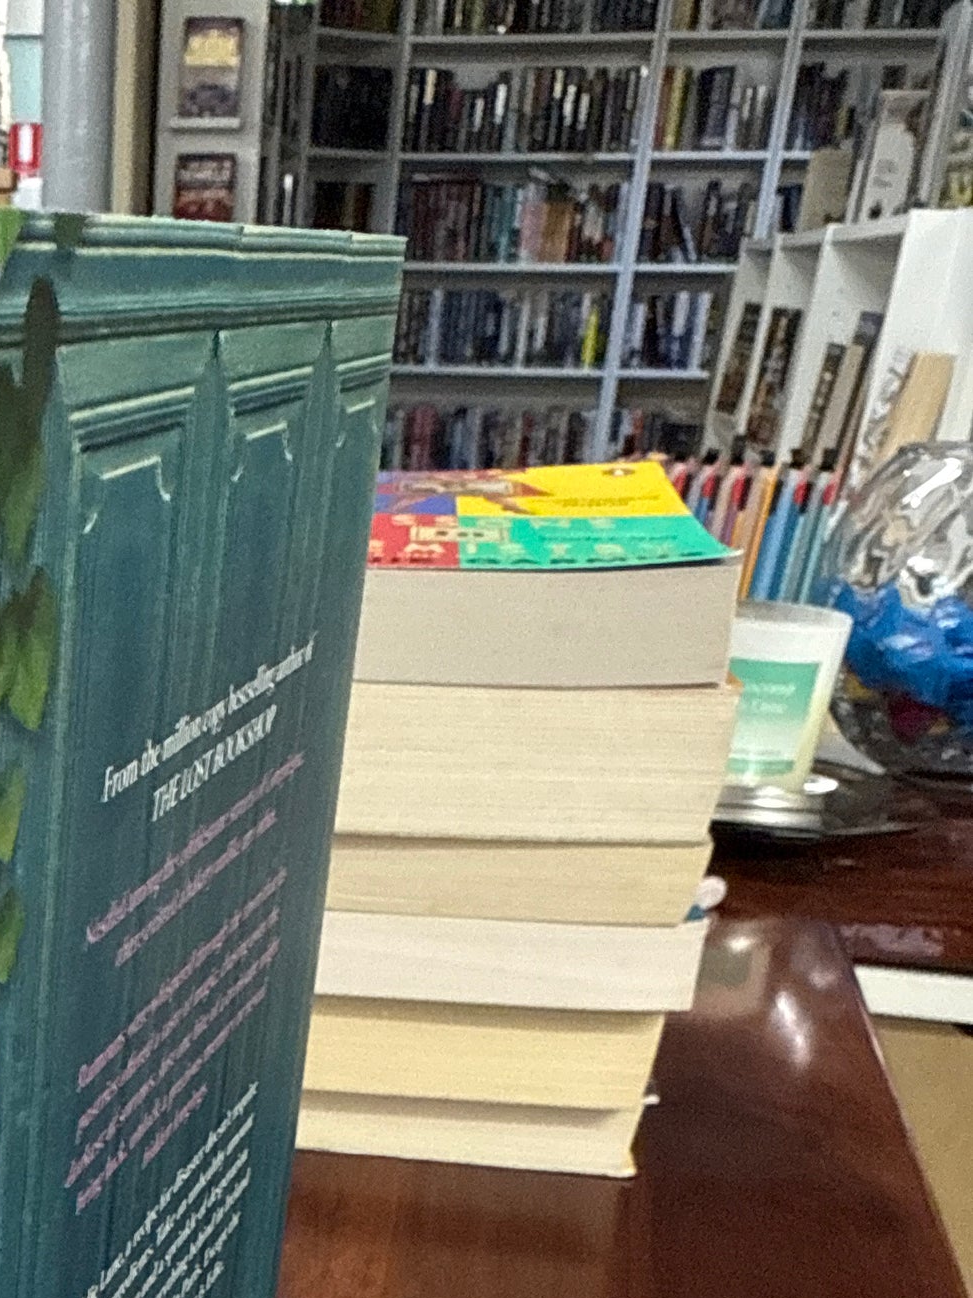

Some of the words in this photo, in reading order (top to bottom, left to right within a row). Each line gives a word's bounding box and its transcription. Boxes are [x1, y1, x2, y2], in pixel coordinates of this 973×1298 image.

[103, 759, 138, 802] From
[140, 739, 160, 776] the
[161, 715, 202, 760] million
[152, 773, 180, 821] THE
[179, 749, 213, 800] LOST
[212, 704, 277, 773] BOOKSHOP
